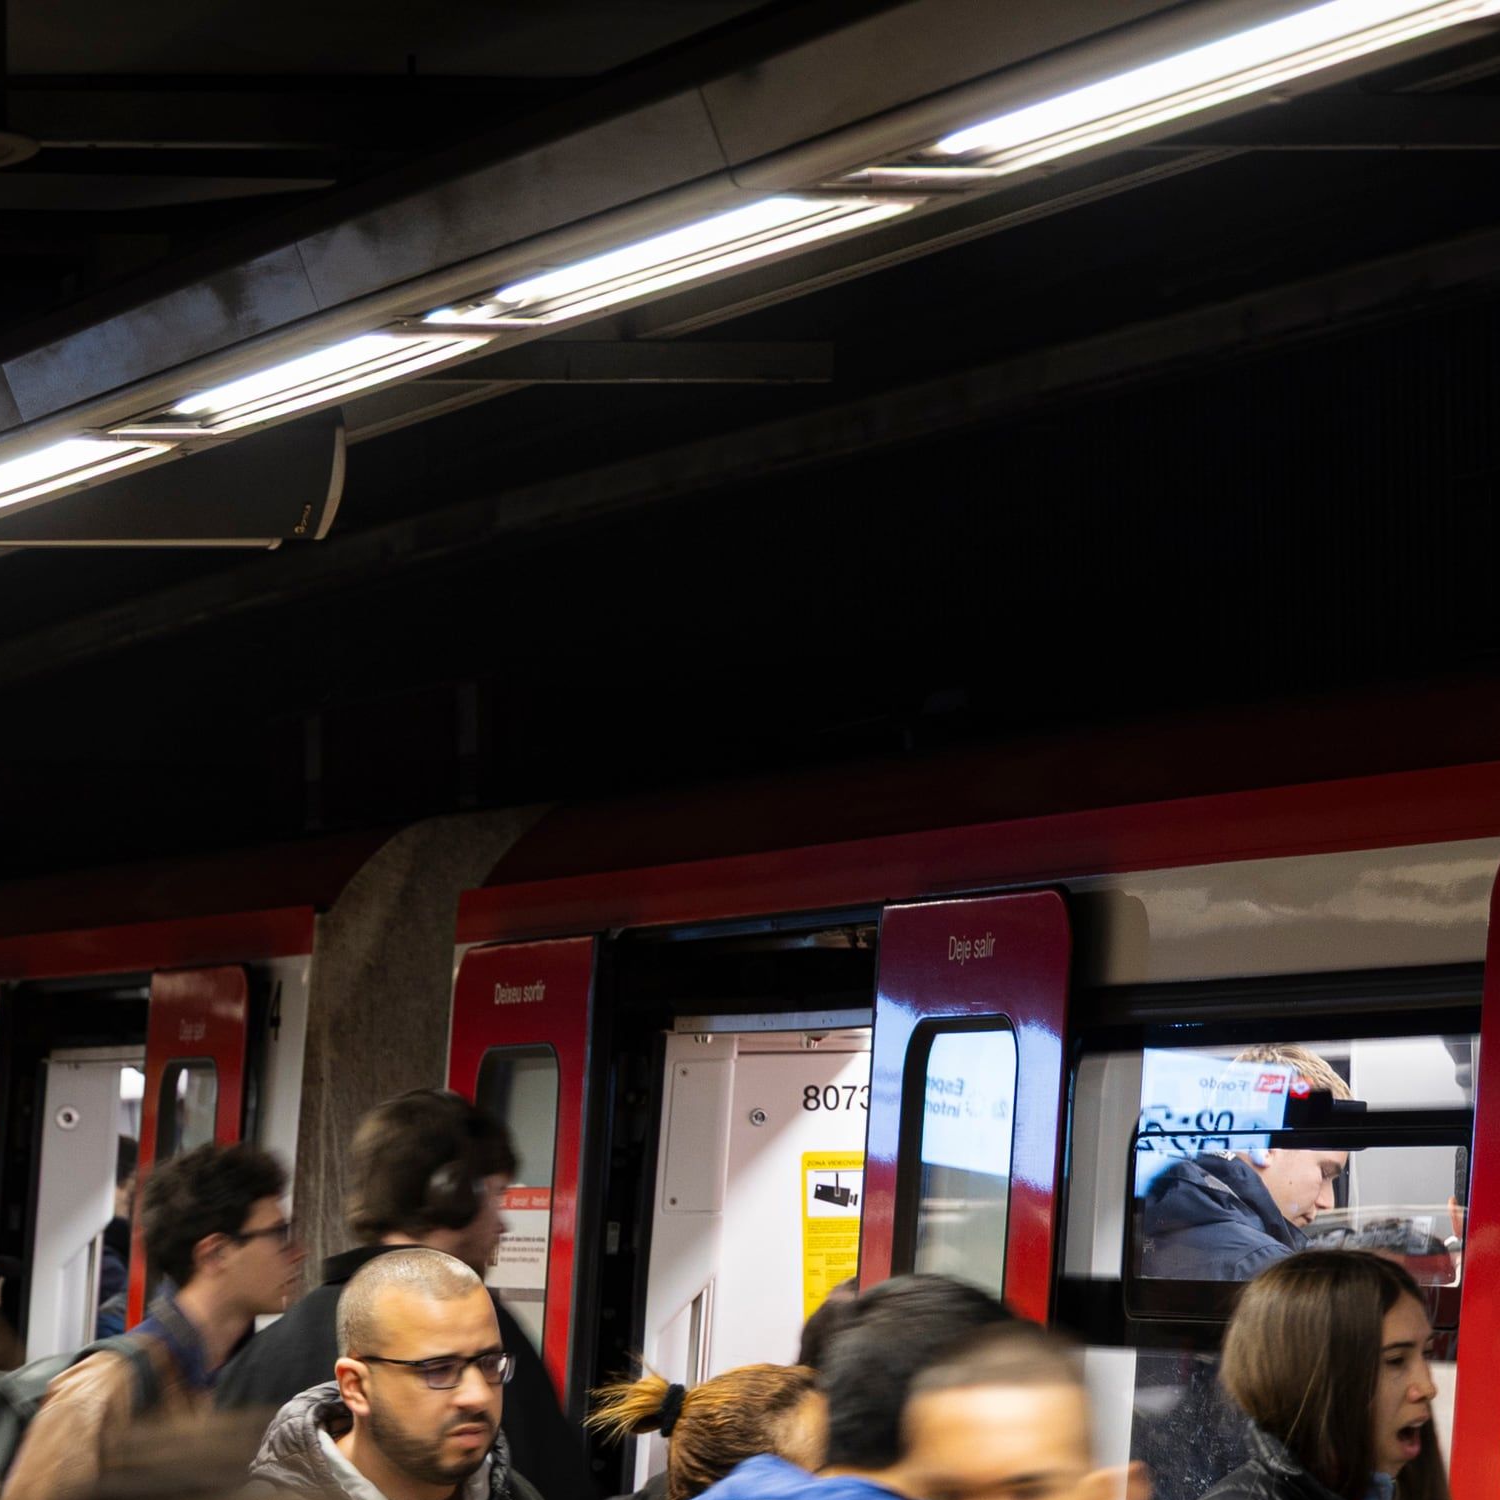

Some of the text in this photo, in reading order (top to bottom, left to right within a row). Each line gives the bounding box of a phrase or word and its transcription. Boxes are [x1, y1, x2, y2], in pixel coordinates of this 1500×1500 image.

[949, 931, 996, 966] Deje salir
[494, 979, 546, 1005] Deixeu sortir
